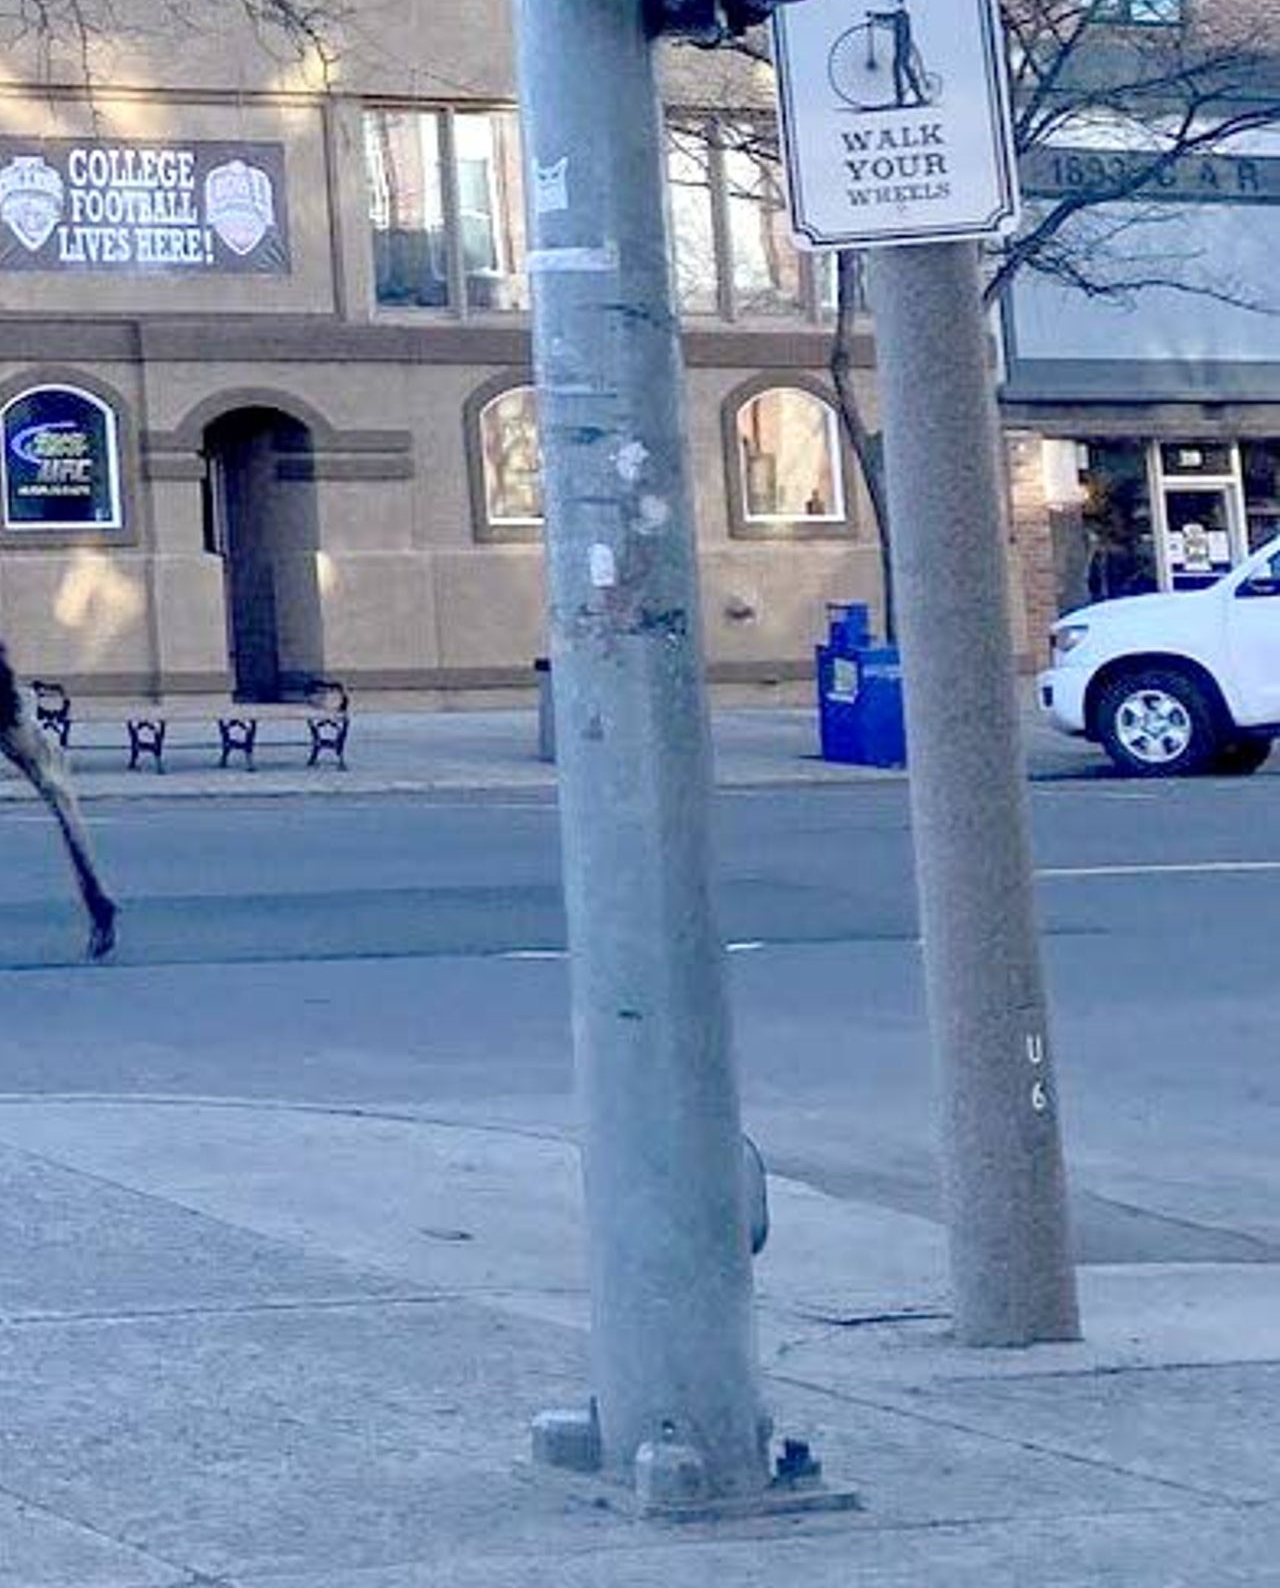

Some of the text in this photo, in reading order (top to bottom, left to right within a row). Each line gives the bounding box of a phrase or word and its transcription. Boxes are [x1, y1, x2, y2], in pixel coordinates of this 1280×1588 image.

[841, 124, 944, 151] WALK
[69, 150, 195, 189] COLLEGE
[844, 153, 948, 180] YOUR
[70, 189, 198, 224] FOOTBALL
[847, 183, 951, 206] WHEELS
[57, 227, 214, 264] LIVES HERE!
